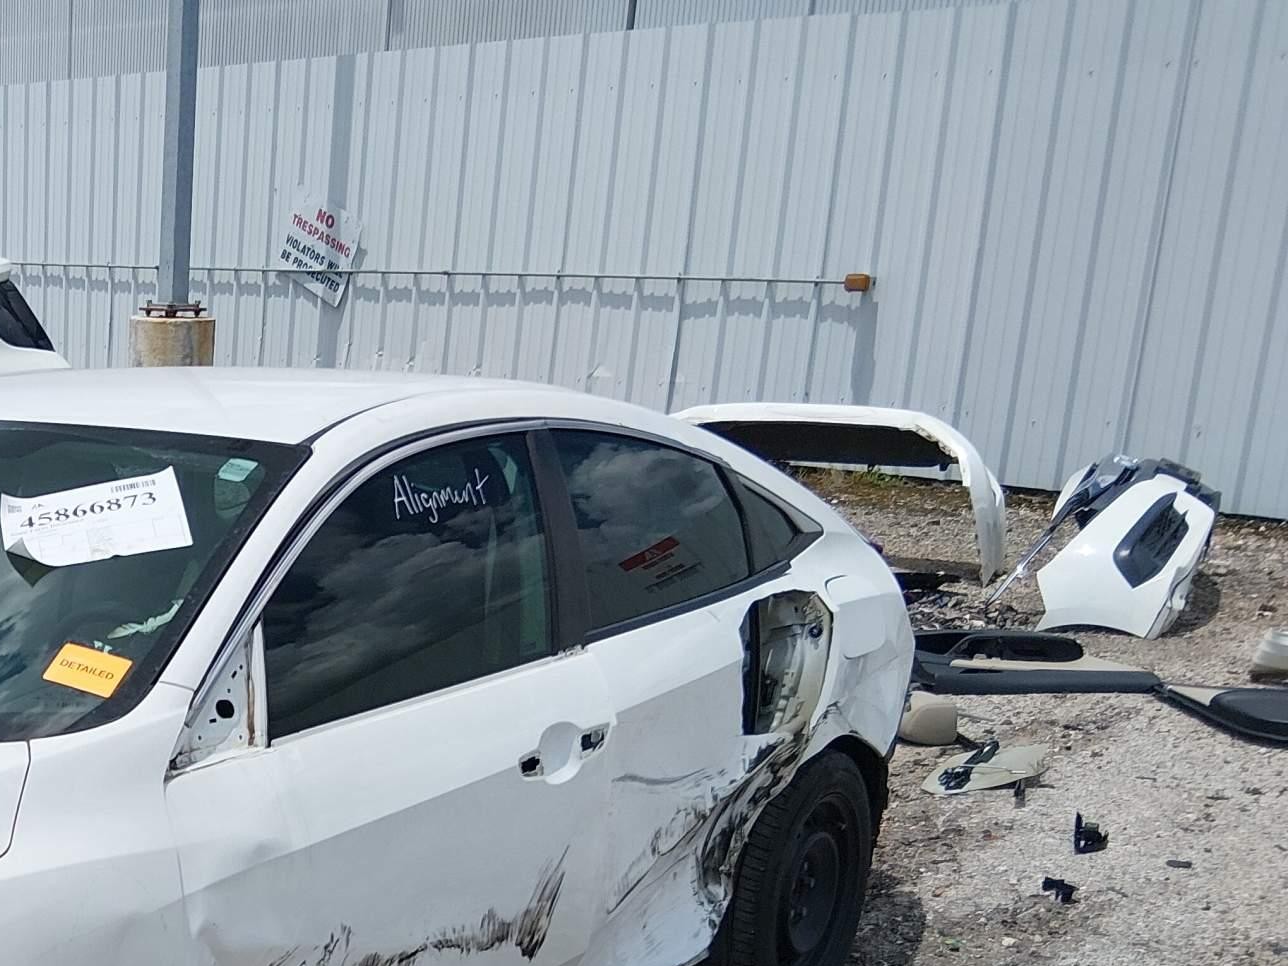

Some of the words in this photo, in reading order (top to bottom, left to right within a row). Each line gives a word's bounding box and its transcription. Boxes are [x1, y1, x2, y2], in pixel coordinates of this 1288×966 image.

[292, 213, 351, 258] TRESPASSING
[315, 208, 335, 229] NO
[285, 233, 326, 266] VIOLATORS
[280, 249, 292, 263] BE
[292, 256, 340, 293] PROSECUTED
[19, 491, 157, 529] 45866873
[394, 468, 489, 523] Alignment
[59, 658, 114, 680] DETAILED
